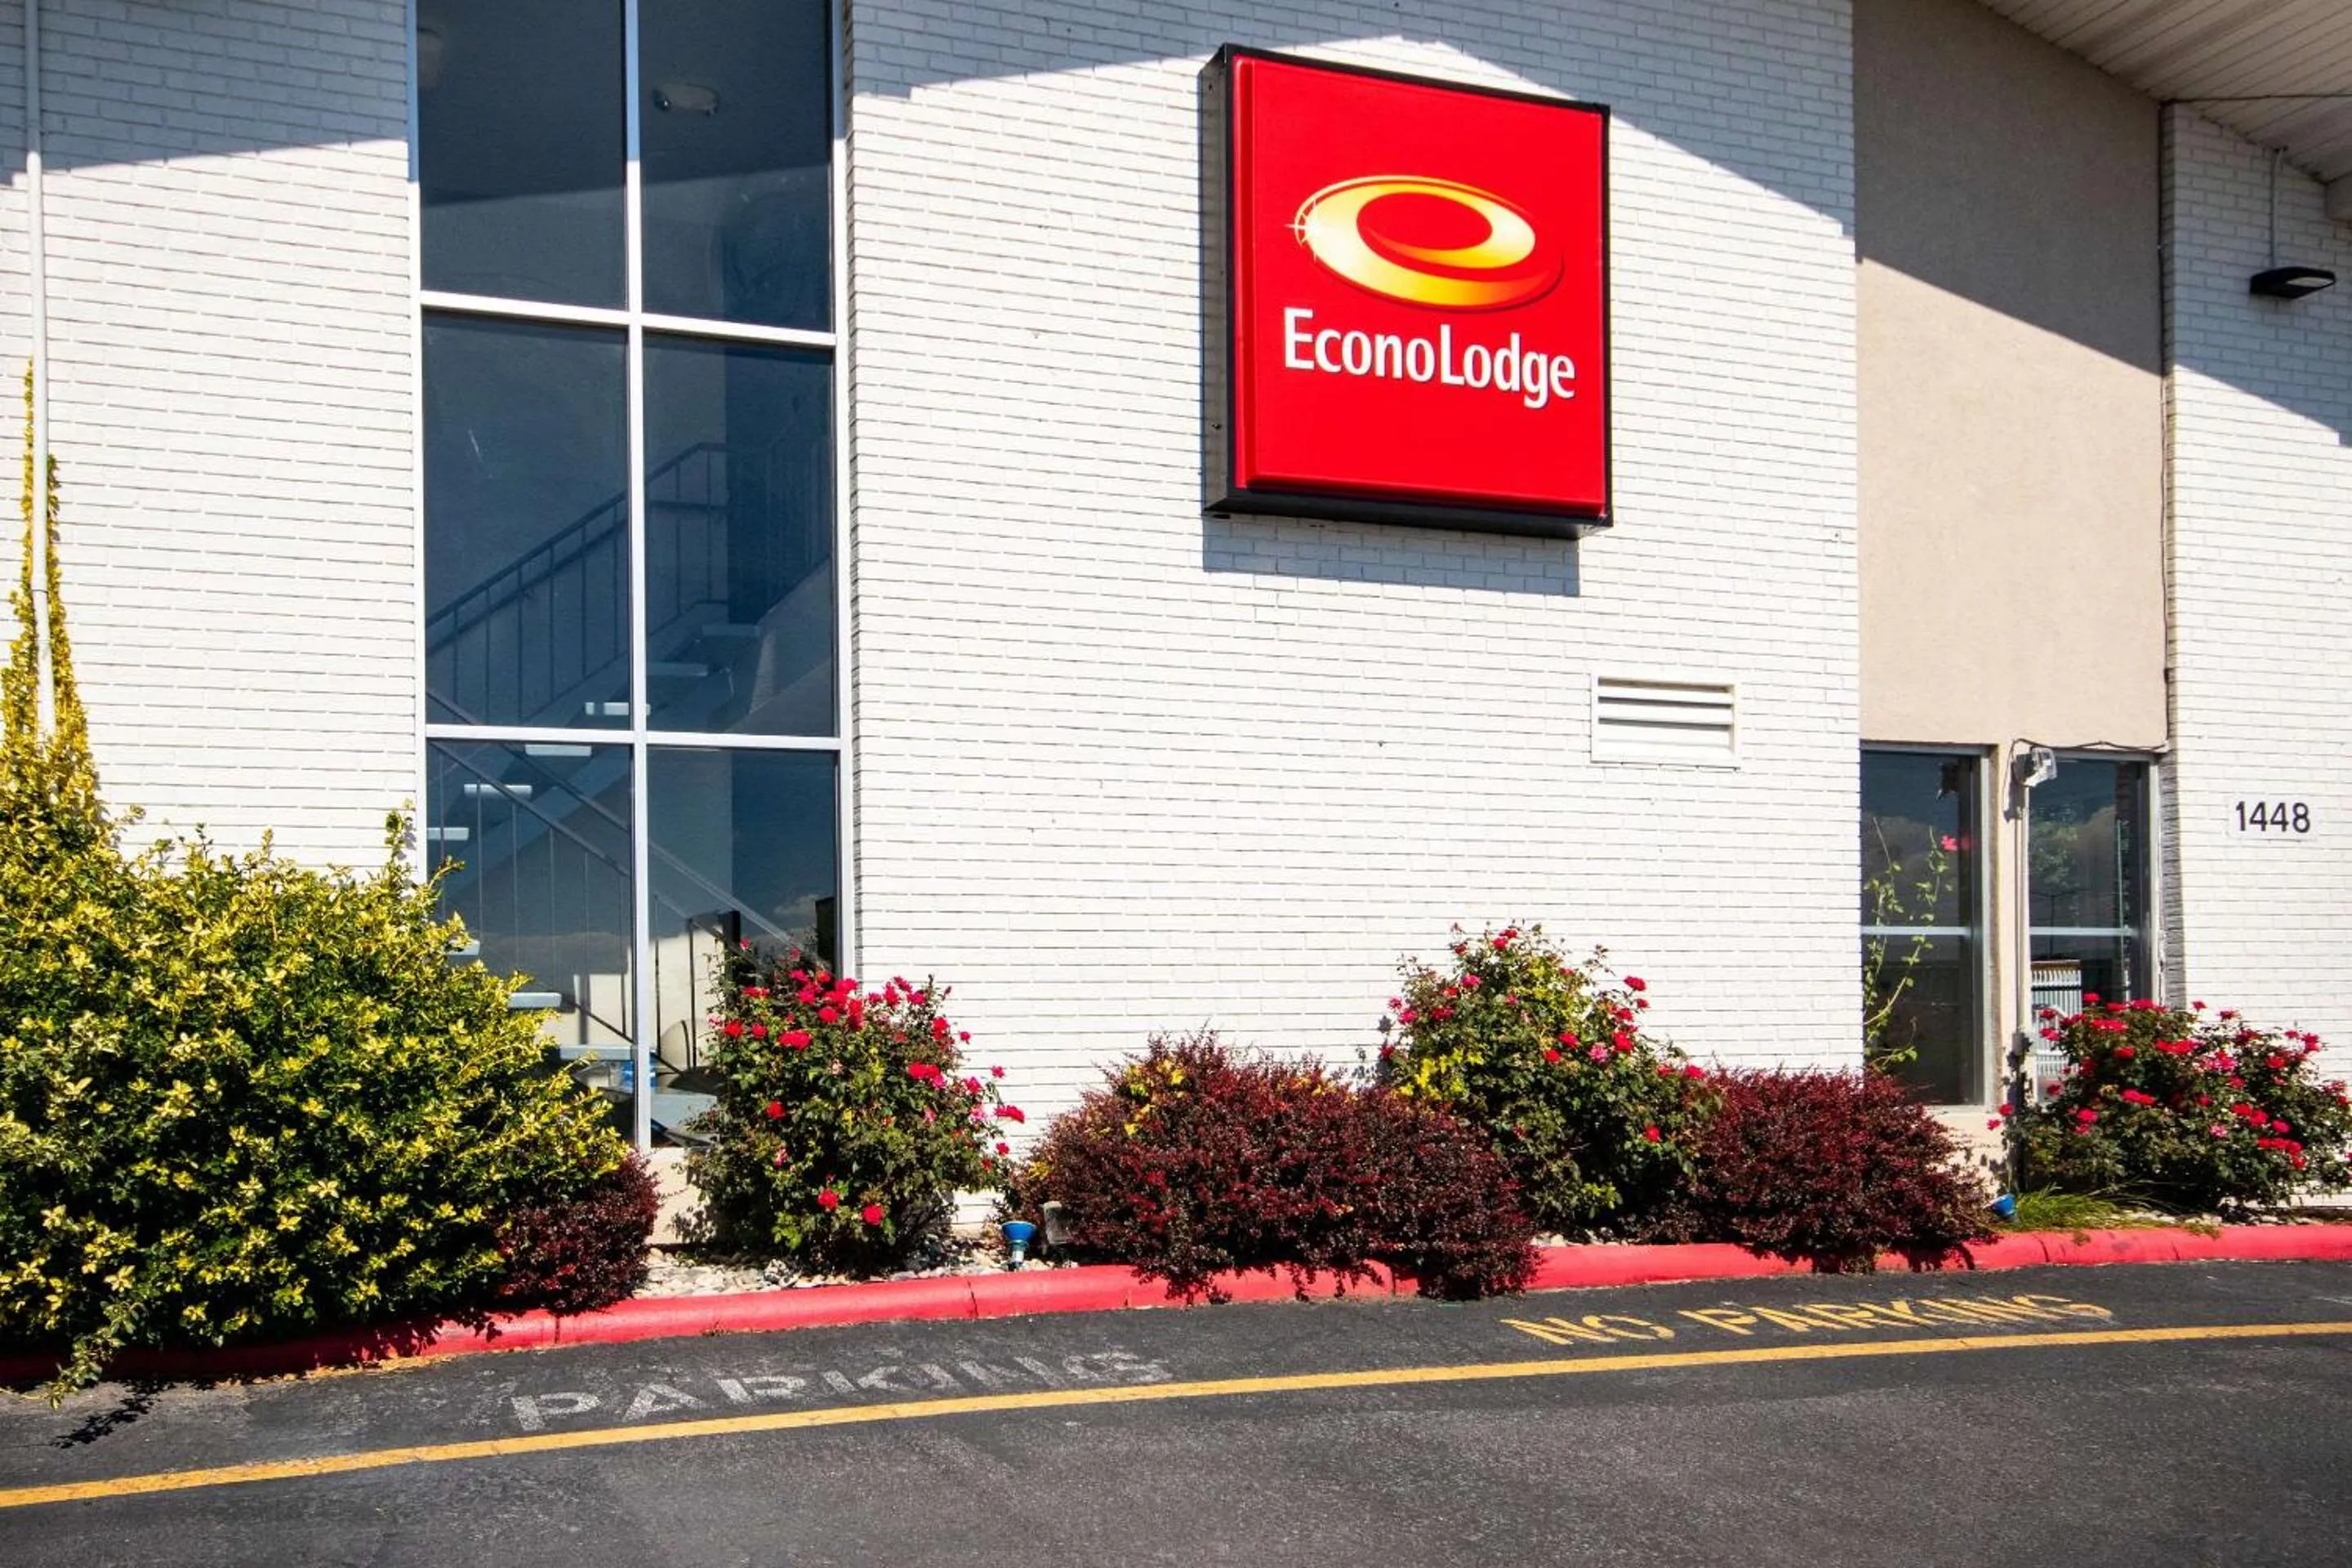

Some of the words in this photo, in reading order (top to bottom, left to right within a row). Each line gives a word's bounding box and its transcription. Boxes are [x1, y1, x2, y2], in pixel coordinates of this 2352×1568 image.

[1283, 306, 1576, 409] EconoLodge
[2236, 800, 2310, 833] 1448
[1499, 1314, 1675, 1345] NO
[1677, 1294, 2115, 1335] PARKING
